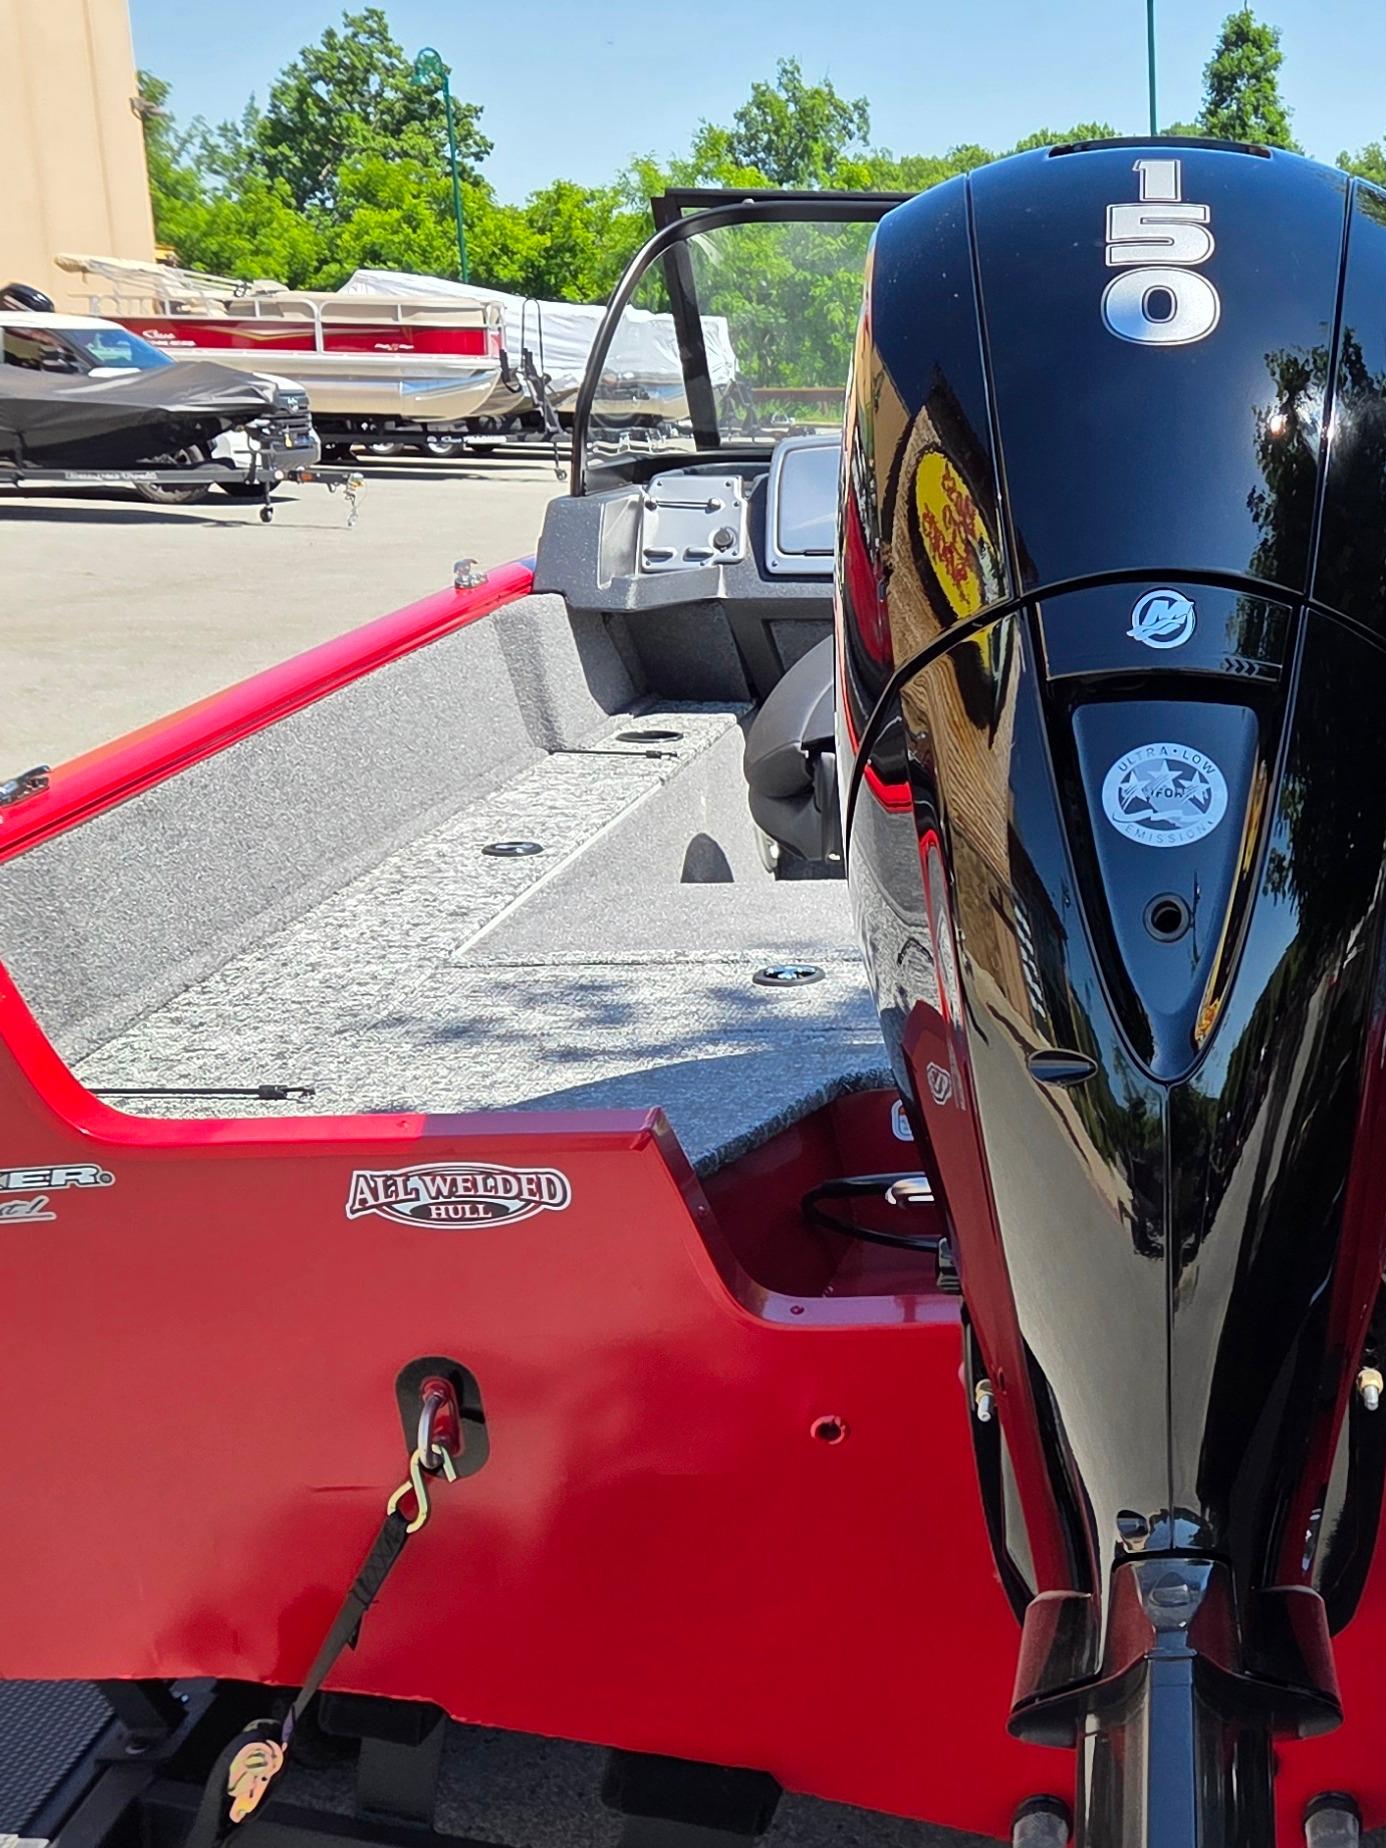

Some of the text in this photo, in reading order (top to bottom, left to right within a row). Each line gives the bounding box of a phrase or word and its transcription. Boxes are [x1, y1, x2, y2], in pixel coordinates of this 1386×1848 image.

[1100, 159, 1221, 346] 150
[1117, 746, 1216, 775] ULTRA LOW
[352, 1172, 564, 1210] ALL WELDED
[429, 1204, 493, 1219] HULL
